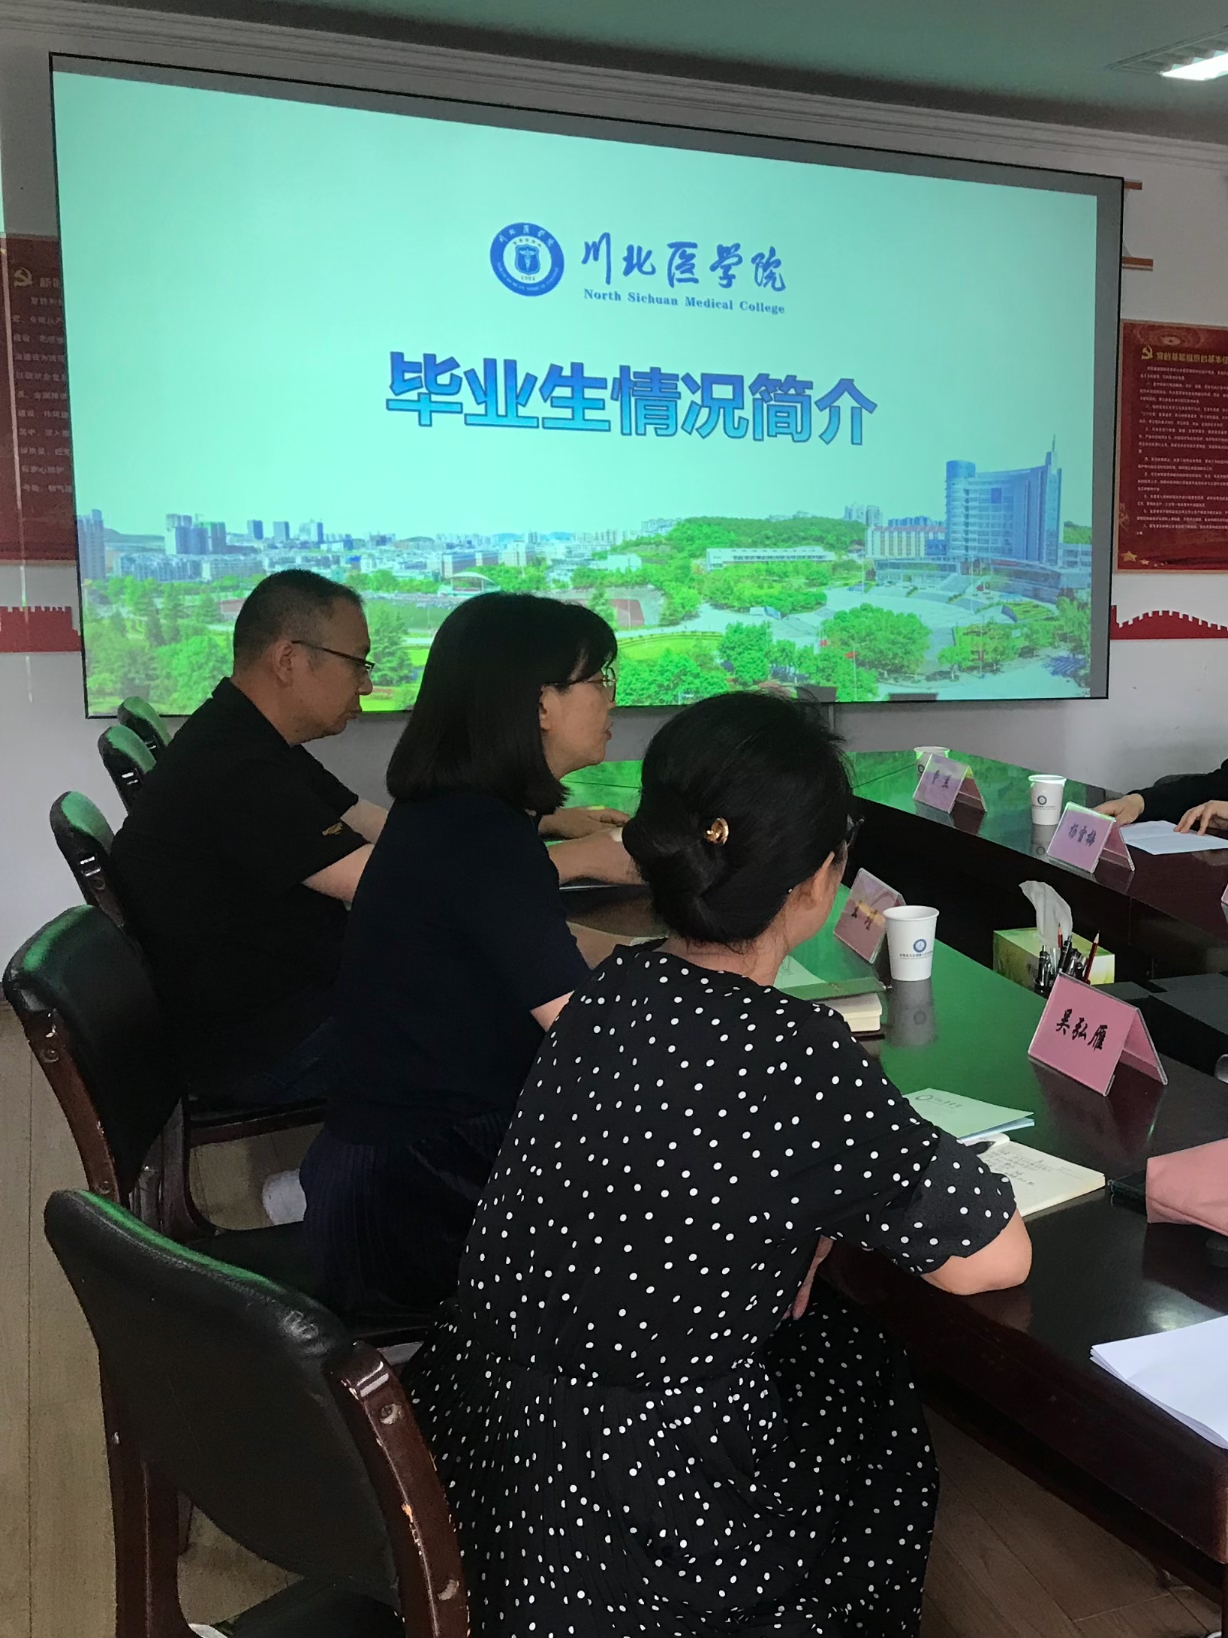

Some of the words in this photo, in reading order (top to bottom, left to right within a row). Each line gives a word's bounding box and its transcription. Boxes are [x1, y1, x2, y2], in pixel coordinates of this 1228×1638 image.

[581, 231, 787, 292] 川北医学院
[584, 288, 621, 302] North
[628, 291, 679, 306] Sichuan
[685, 295, 734, 311] Medical
[739, 299, 786, 315] College
[385, 350, 879, 446] 毕业生情况简介
[1056, 1008, 1108, 1051] 吴弘雁
